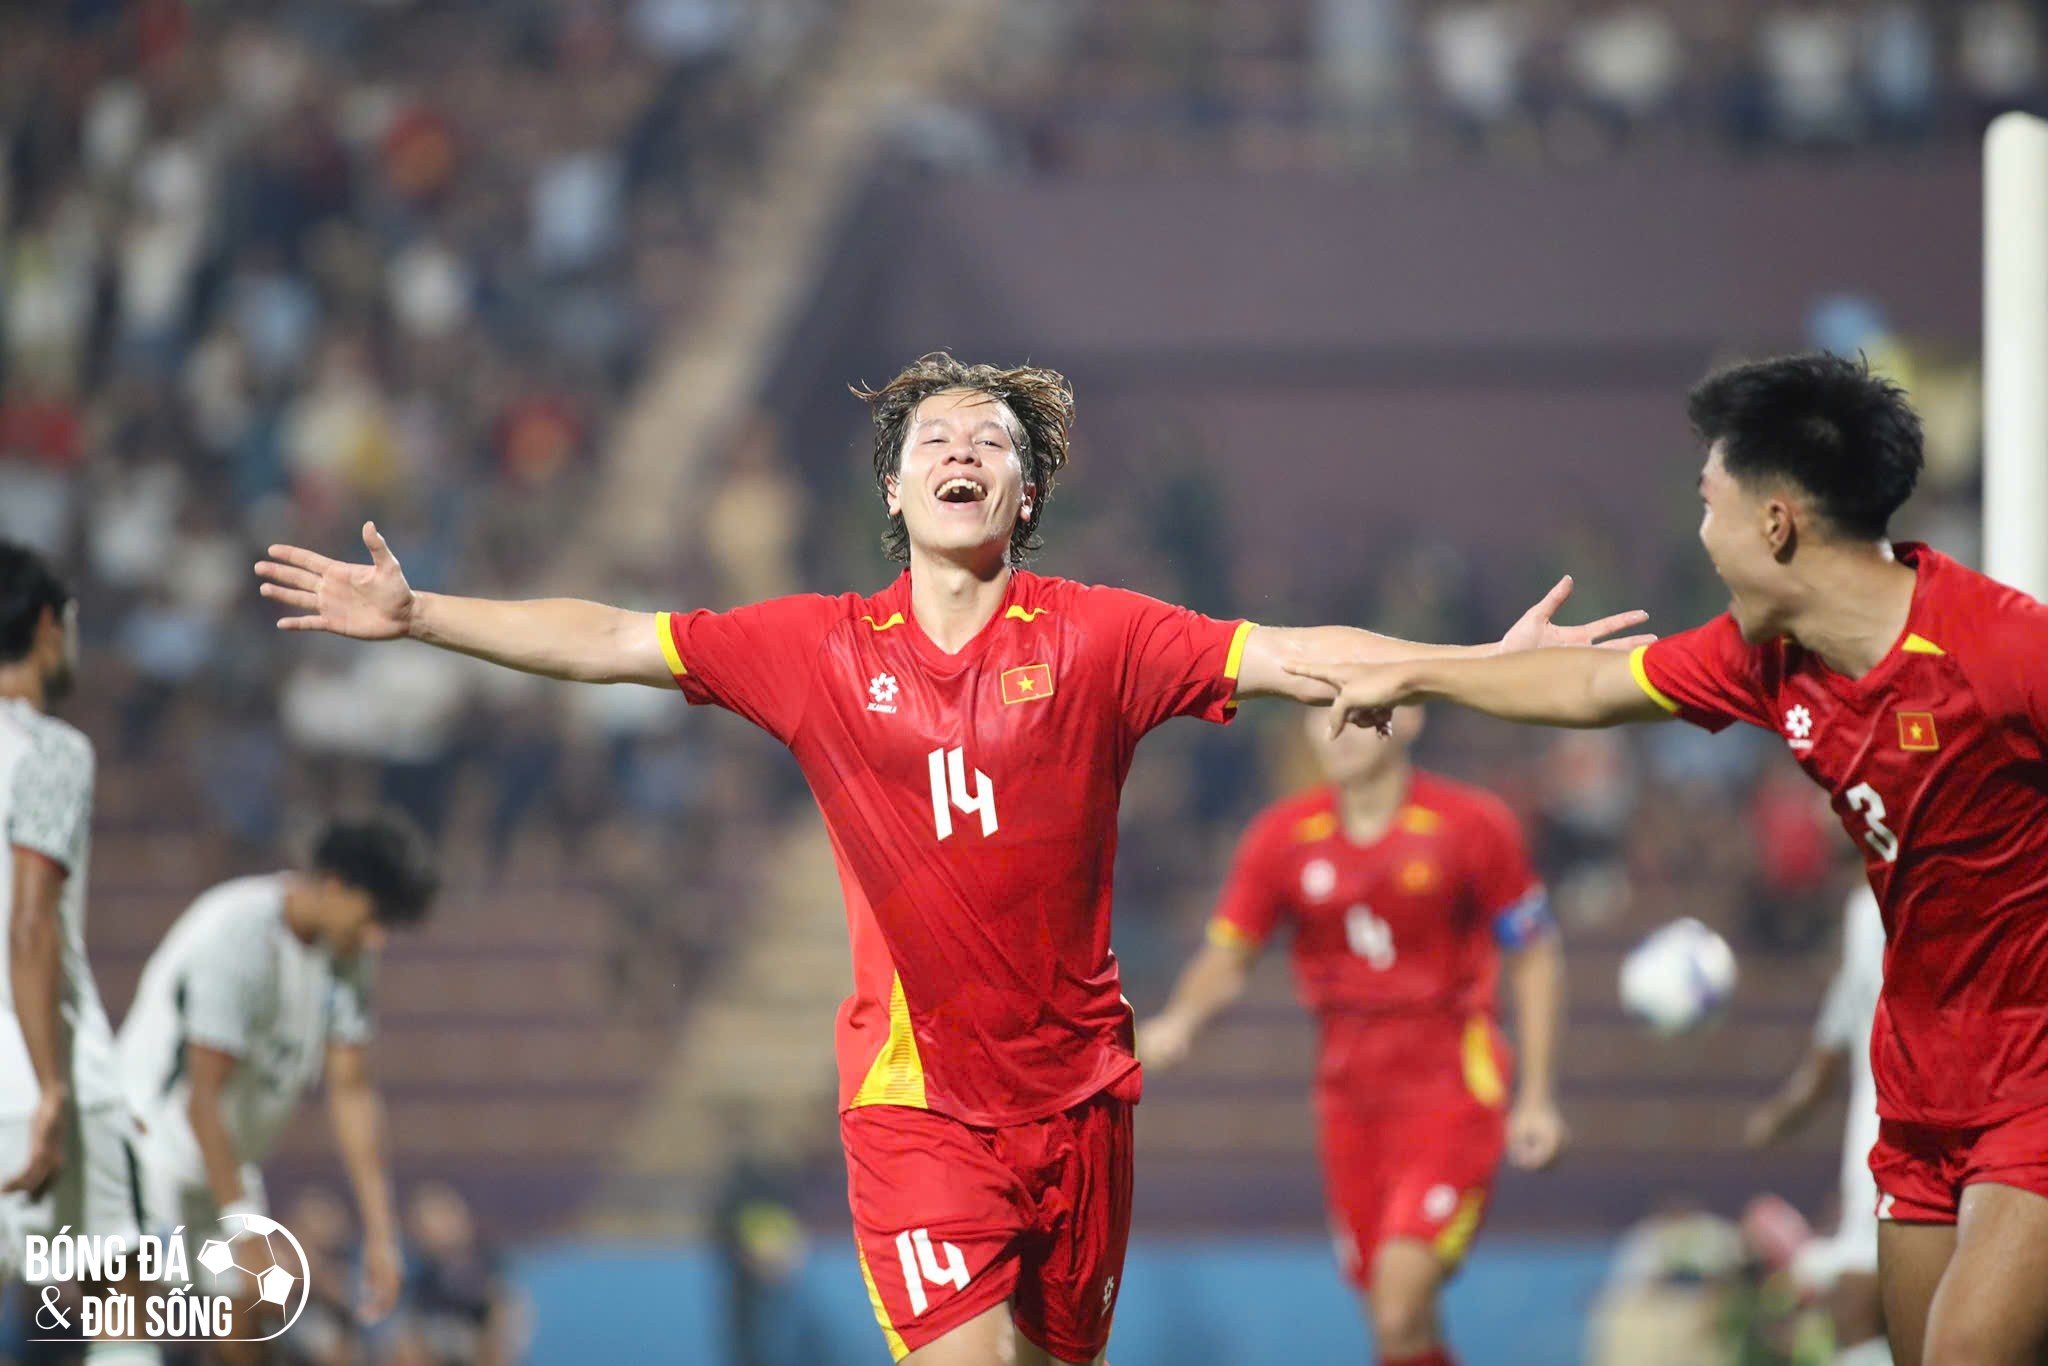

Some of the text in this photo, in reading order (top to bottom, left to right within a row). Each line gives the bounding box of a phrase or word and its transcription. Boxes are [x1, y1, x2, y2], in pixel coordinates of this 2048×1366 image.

[928, 746, 999, 841] 14
[1846, 781, 1899, 862] 3
[895, 1228, 971, 1317] 14
